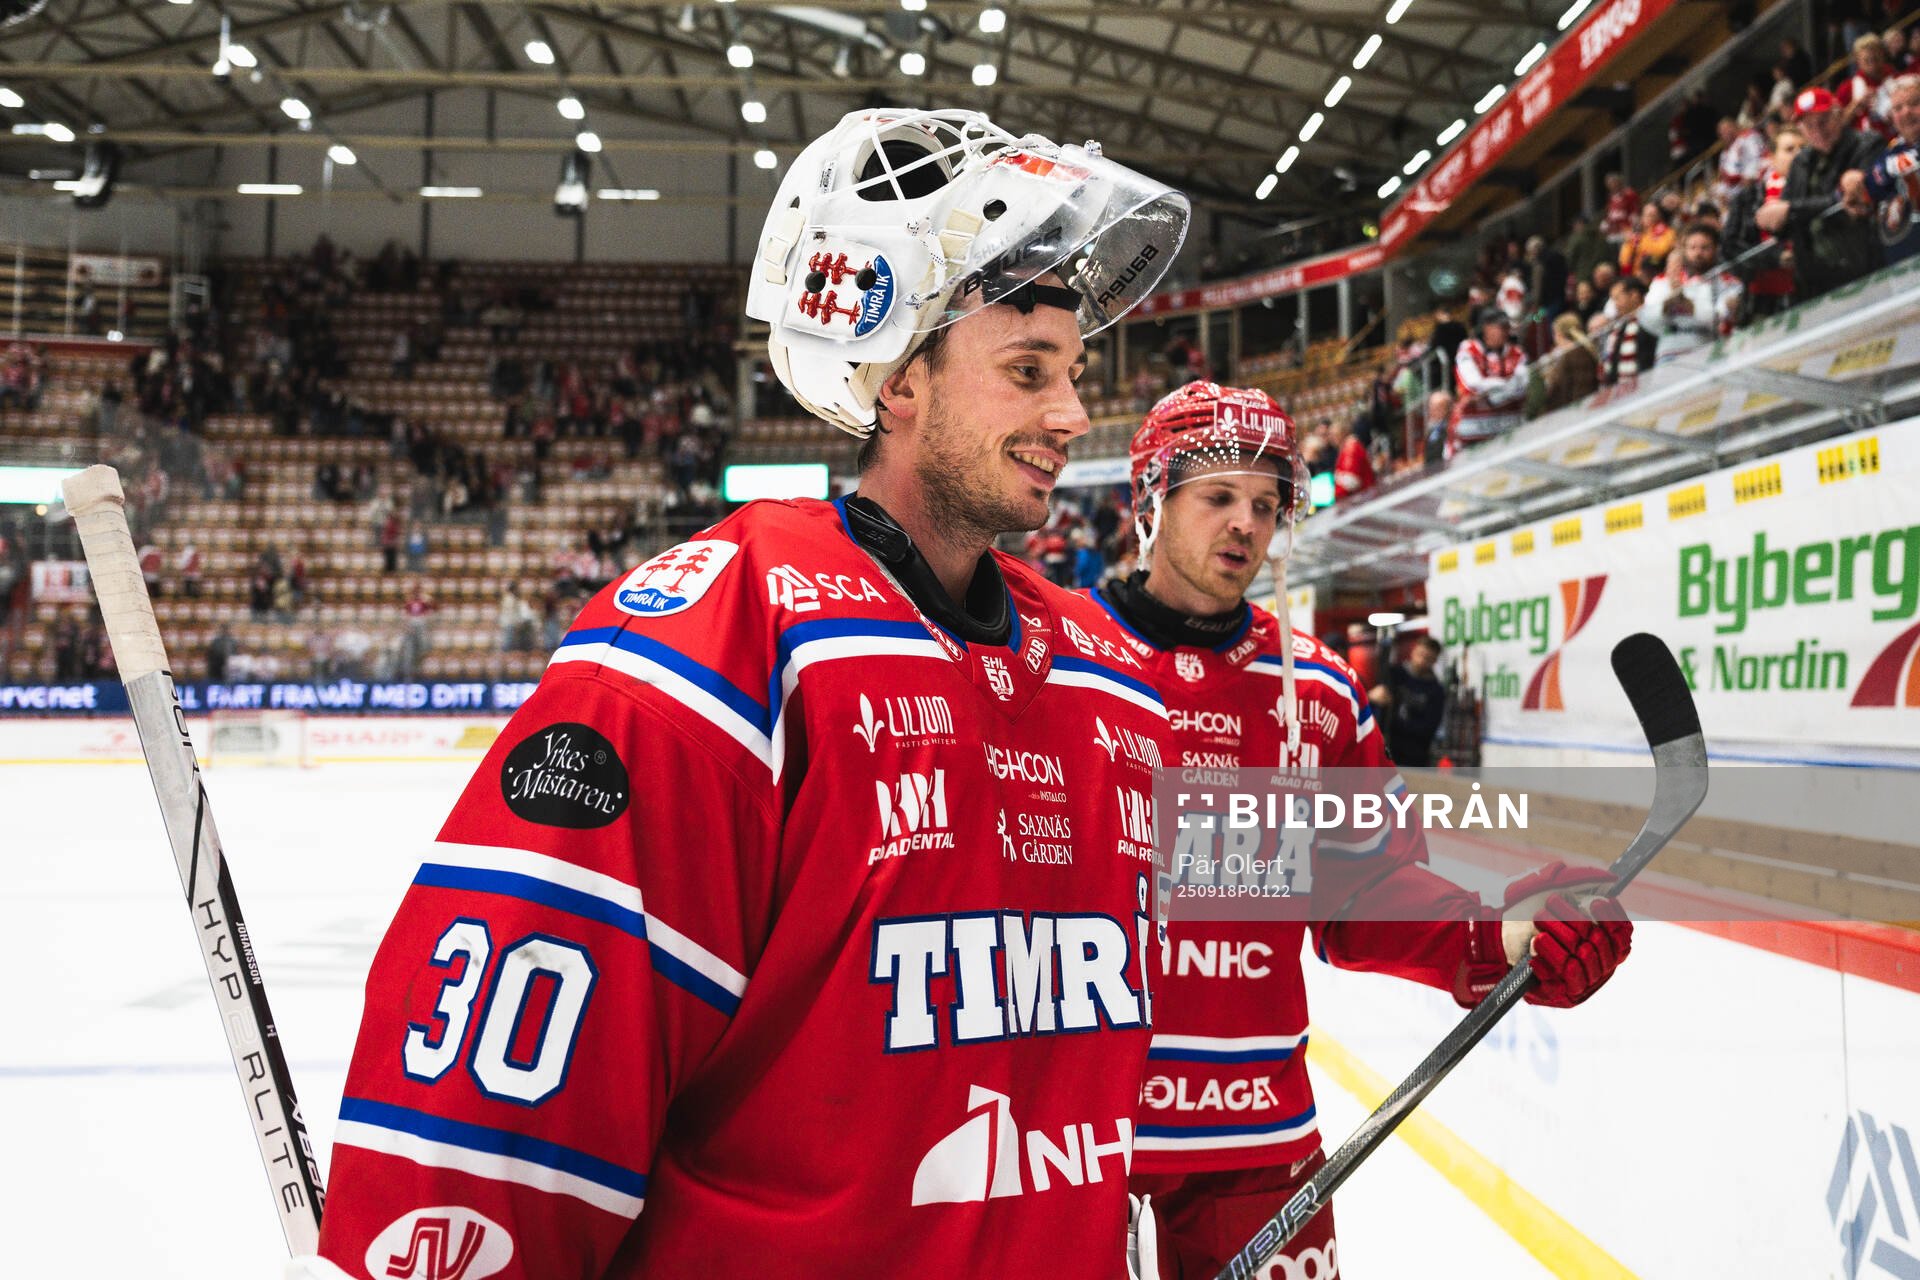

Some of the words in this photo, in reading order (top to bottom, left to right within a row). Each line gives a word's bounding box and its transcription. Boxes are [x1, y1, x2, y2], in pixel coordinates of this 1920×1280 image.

[875, 273, 891, 287] IK
[963, 226, 1063, 298] BUER
[864, 287, 887, 324] TIMRÅ
[1241, 405, 1285, 440] LILIUM
[815, 572, 887, 604] SCA
[1679, 524, 1920, 634] Byberg
[623, 591, 657, 607] TIMRÅ
[653, 597, 669, 610] IK
[1443, 590, 1550, 655] Byberg
[981, 655, 1007, 670] SHL
[1027, 639, 1047, 671] EAB
[1091, 634, 1142, 670] SCA
[1711, 639, 1847, 691] Nordin
[984, 668, 1015, 696] 50
[885, 695, 954, 737] LILIUM
[533, 731, 590, 772] Yrkes
[1115, 725, 1163, 772] LILIUM
[1182, 750, 1239, 770] SAXNÄS
[510, 768, 615, 814] Mästaren
[1018, 813, 1071, 839] SAXNÄS
[1022, 839, 1073, 865] GÅRDEN
[235, 921, 262, 986] JOHANSSON
[1176, 940, 1274, 978] NHC
[401, 916, 600, 1109] 30
[1139, 1075, 1279, 1111] OLAGET
